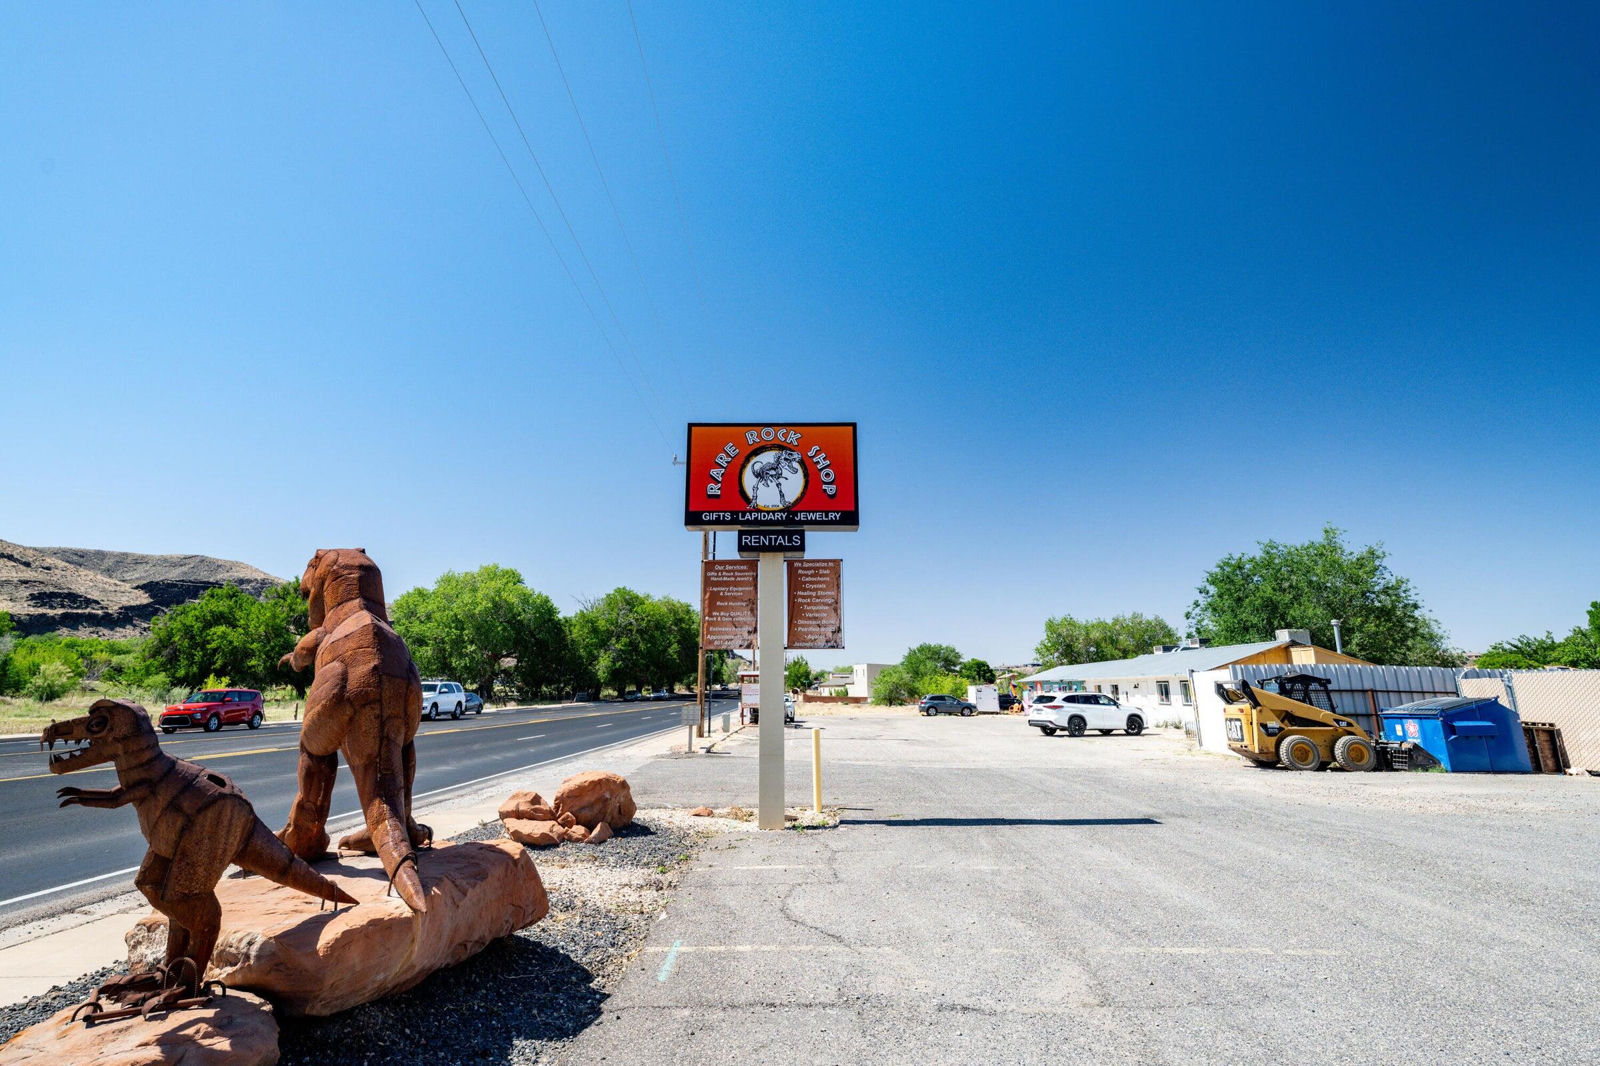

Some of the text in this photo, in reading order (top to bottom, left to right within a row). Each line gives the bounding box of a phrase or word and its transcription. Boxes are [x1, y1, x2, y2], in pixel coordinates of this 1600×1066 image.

[707, 427, 837, 495] RARE ROCK SHOP
[702, 512, 841, 521] GIFTS LAPIDARY JEWELRY
[742, 535, 801, 546] RENTALS
[1227, 720, 1242, 740] CAT
